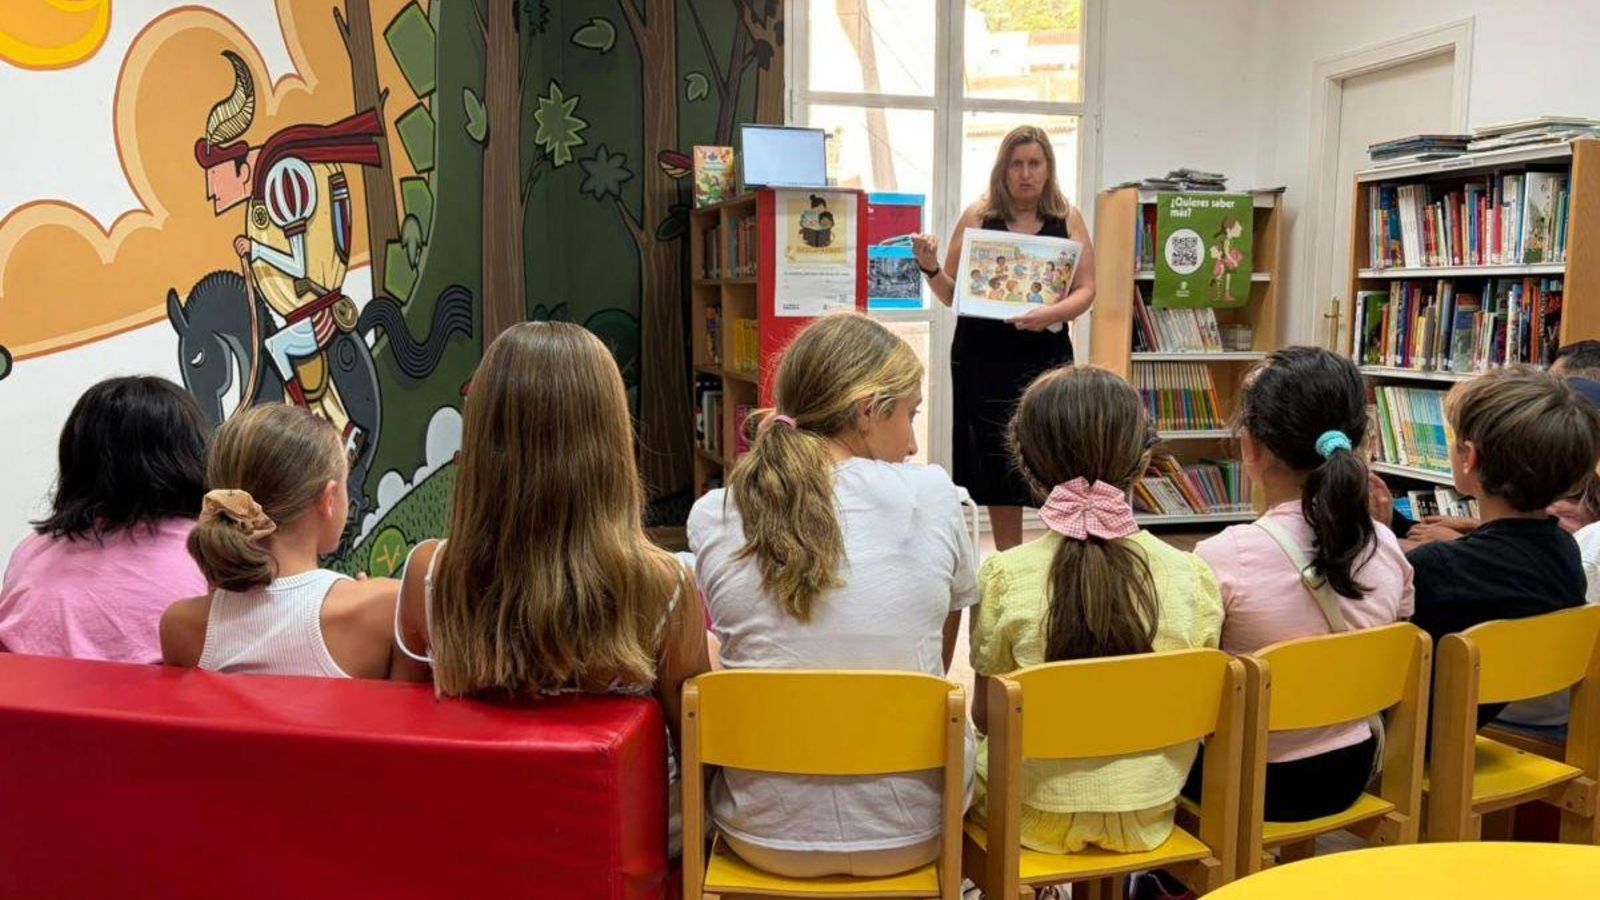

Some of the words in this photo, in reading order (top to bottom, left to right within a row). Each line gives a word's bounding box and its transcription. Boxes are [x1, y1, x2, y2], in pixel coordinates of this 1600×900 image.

[1170, 196, 1209, 208] ¿Quieres
[1211, 197, 1235, 208] saber
[1170, 208, 1192, 218] más?
